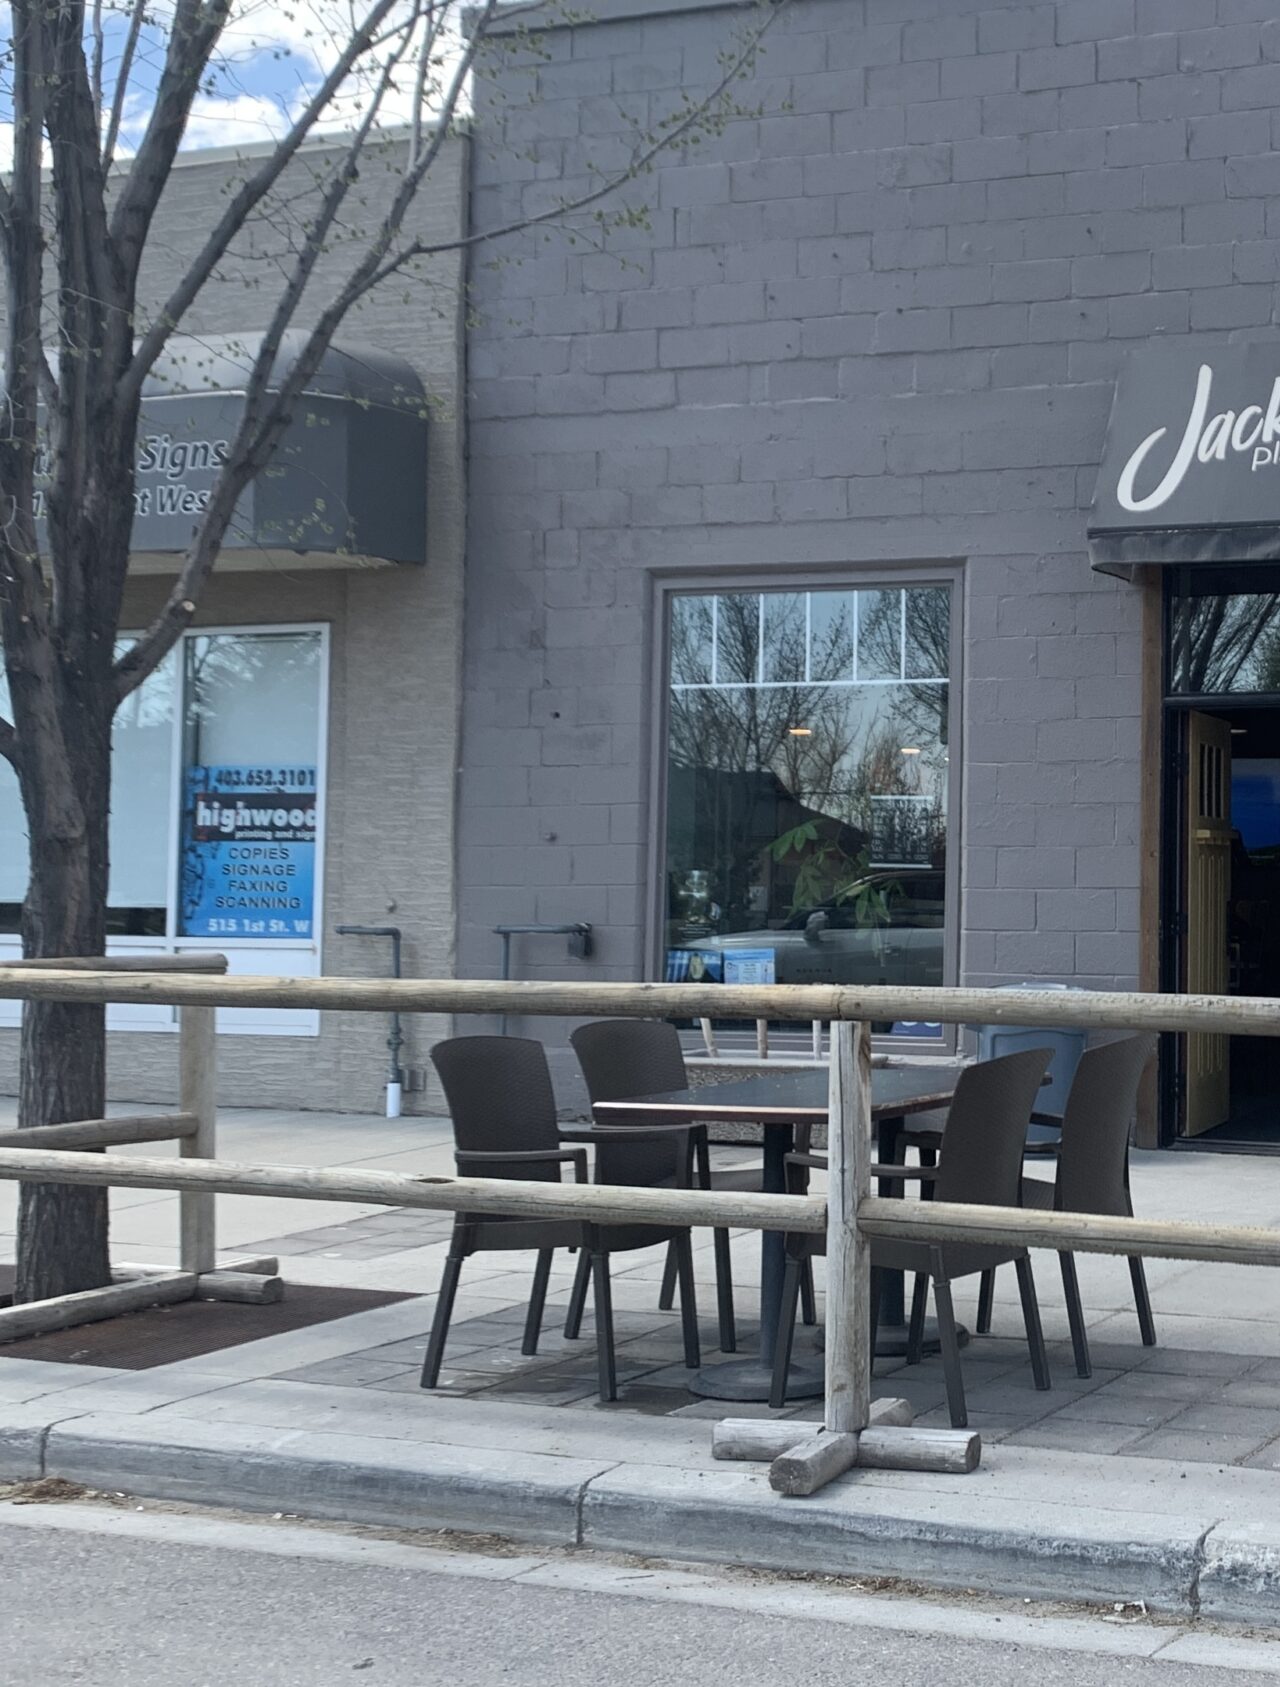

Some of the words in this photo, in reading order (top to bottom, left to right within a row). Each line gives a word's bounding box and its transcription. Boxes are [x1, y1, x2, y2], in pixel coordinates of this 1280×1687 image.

[138, 434, 229, 480] Signs
[156, 485, 211, 515] Wes
[216, 769, 315, 786] 403.652.3101
[229, 848, 290, 860] COPIES
[221, 864, 296, 876] SIGNAGE
[228, 880, 289, 893] FAXING
[215, 896, 301, 909] SCANNING
[207, 918, 238, 932] 515
[242, 919, 265, 933] 1st
[269, 919, 290, 932] St.
[293, 919, 311, 933] W
